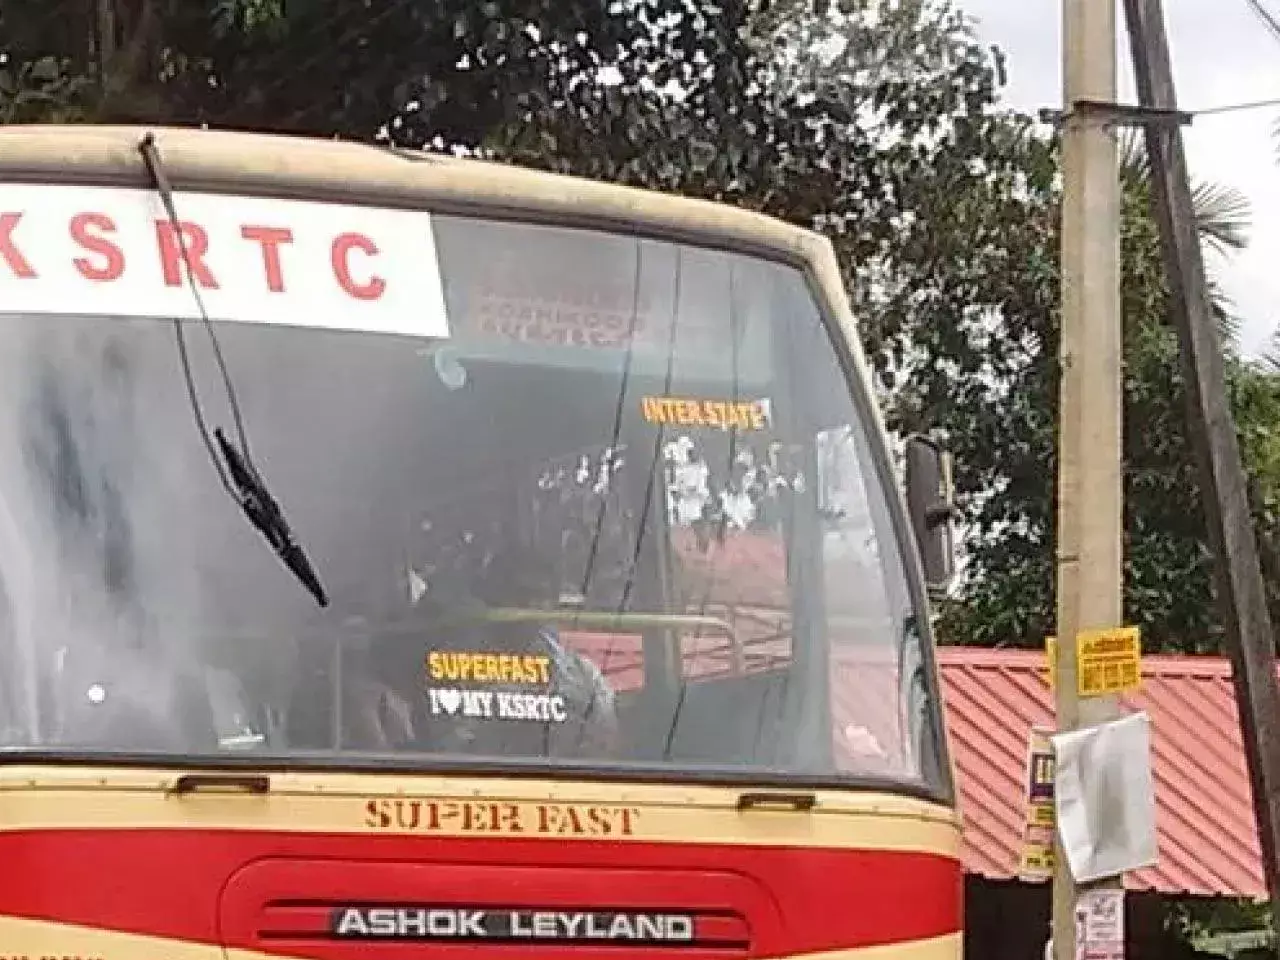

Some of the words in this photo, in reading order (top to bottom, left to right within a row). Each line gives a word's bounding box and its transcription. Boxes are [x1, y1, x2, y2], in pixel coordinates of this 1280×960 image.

[428, 651, 550, 682] SUPERFAST
[496, 692, 568, 722] KSRTC
[366, 799, 524, 832] SUPER
[537, 804, 641, 836] FAST
[337, 908, 488, 936] ASHOK
[509, 911, 694, 940] LEYLAND
